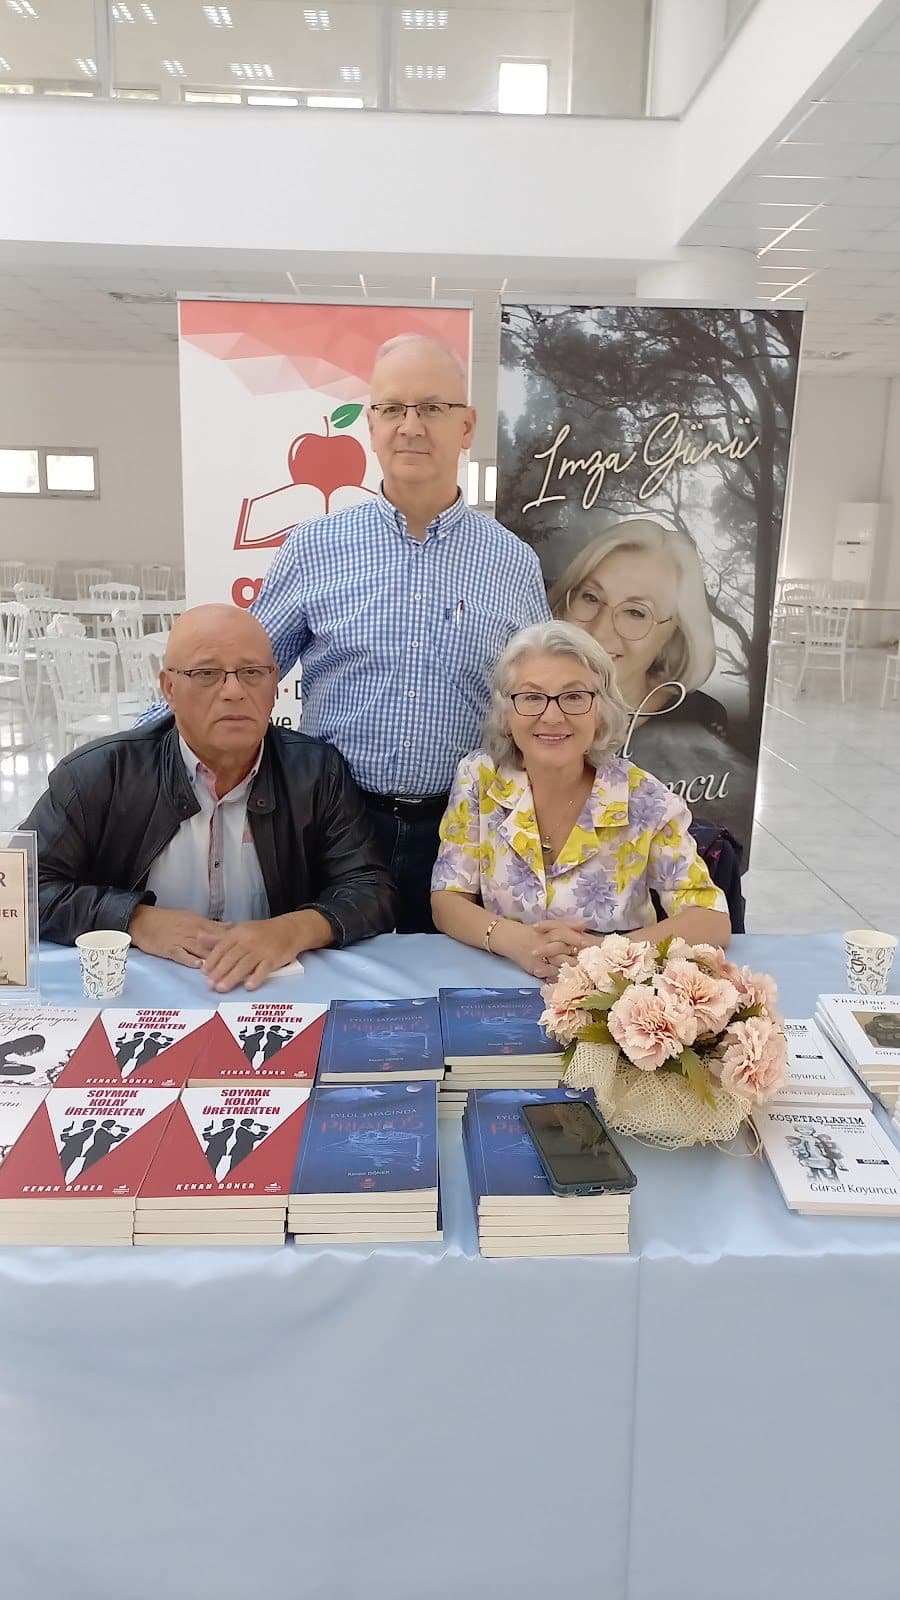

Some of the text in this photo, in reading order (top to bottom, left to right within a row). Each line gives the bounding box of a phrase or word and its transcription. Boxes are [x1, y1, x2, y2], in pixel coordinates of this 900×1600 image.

[522, 412, 759, 513] İmza Günü
[136, 1009, 180, 1017] SOYMAK
[117, 1021, 186, 1029] ÜRETMEKTEN
[87, 1090, 139, 1098] SOYMAK
[221, 1089, 271, 1097] SOYMAK
[89, 1098, 128, 1107] KOLAY
[224, 1097, 262, 1106] KOLAY
[64, 1106, 146, 1117] ÜRETMEKTEN
[202, 1105, 281, 1115] ÜRETMEKTEN
[65, 1184, 104, 1192] DÖNER
[176, 1183, 212, 1191] KENAN
[218, 1182, 255, 1190] DÖNER
[847, 1183, 898, 1196] Koyuncu
